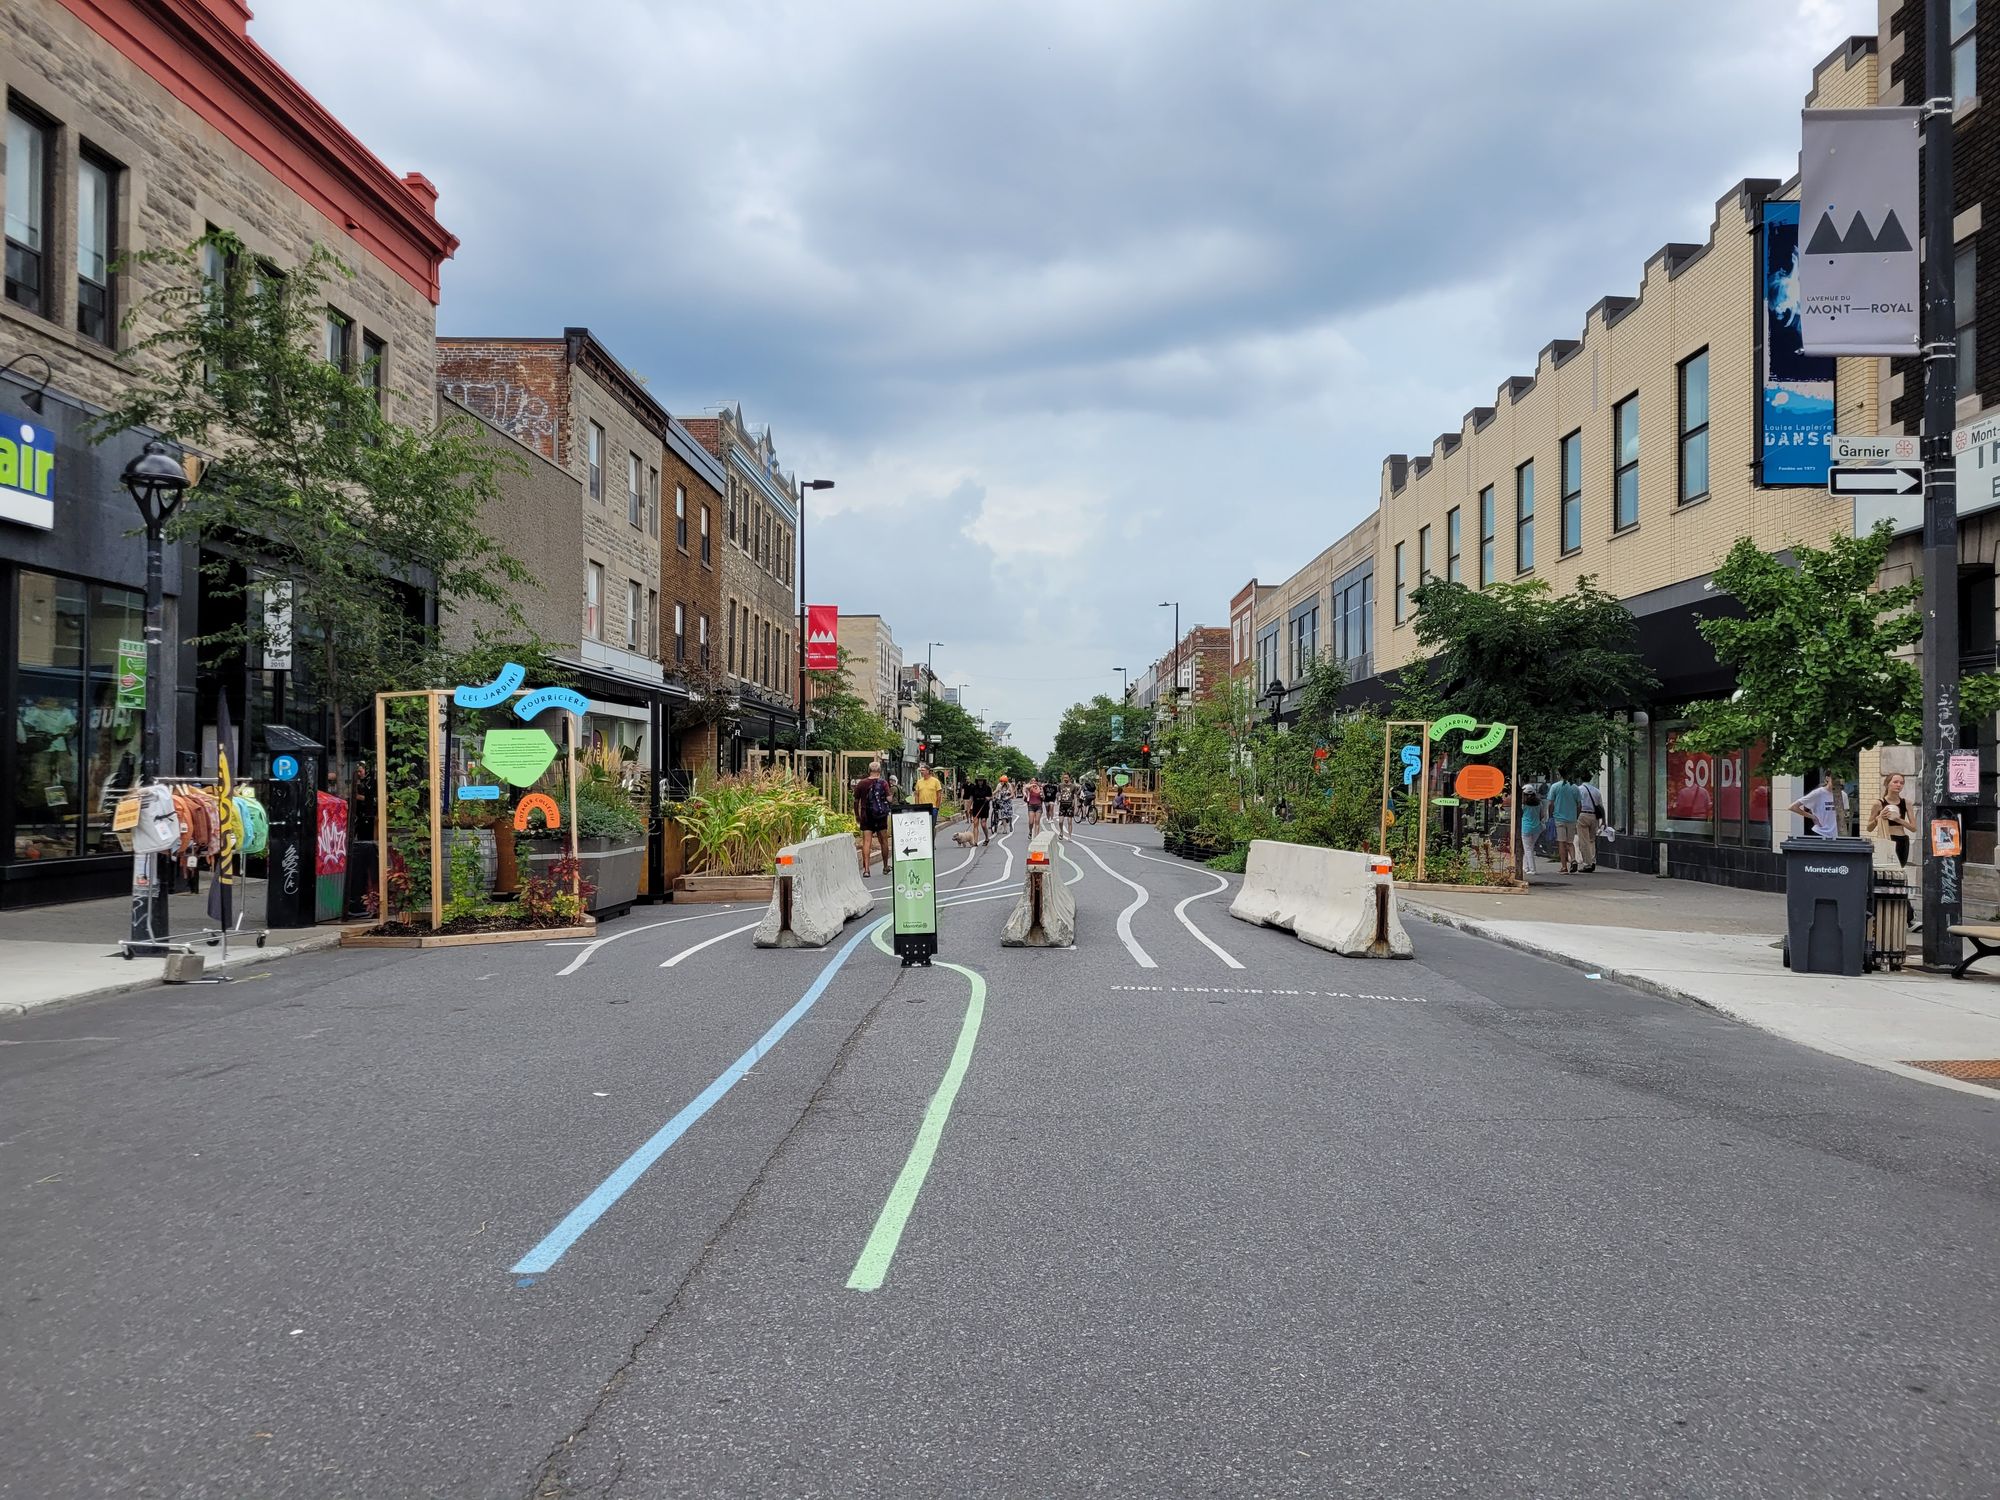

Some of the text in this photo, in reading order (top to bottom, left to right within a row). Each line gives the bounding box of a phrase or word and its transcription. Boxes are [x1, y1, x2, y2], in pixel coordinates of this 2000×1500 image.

[1795, 424, 1832, 432] Lapierre
[1764, 431, 1833, 446] DANSE
[1838, 444, 1890, 458] Garnier
[462, 672, 519, 702] LES JARDINS
[520, 693, 586, 713] NOURRICIERS
[1433, 718, 1473, 737] LES JARDINS
[1464, 727, 1502, 751] NOURRICIERS
[897, 816, 925, 826] Vente
[1804, 865, 1839, 874] Montréal
